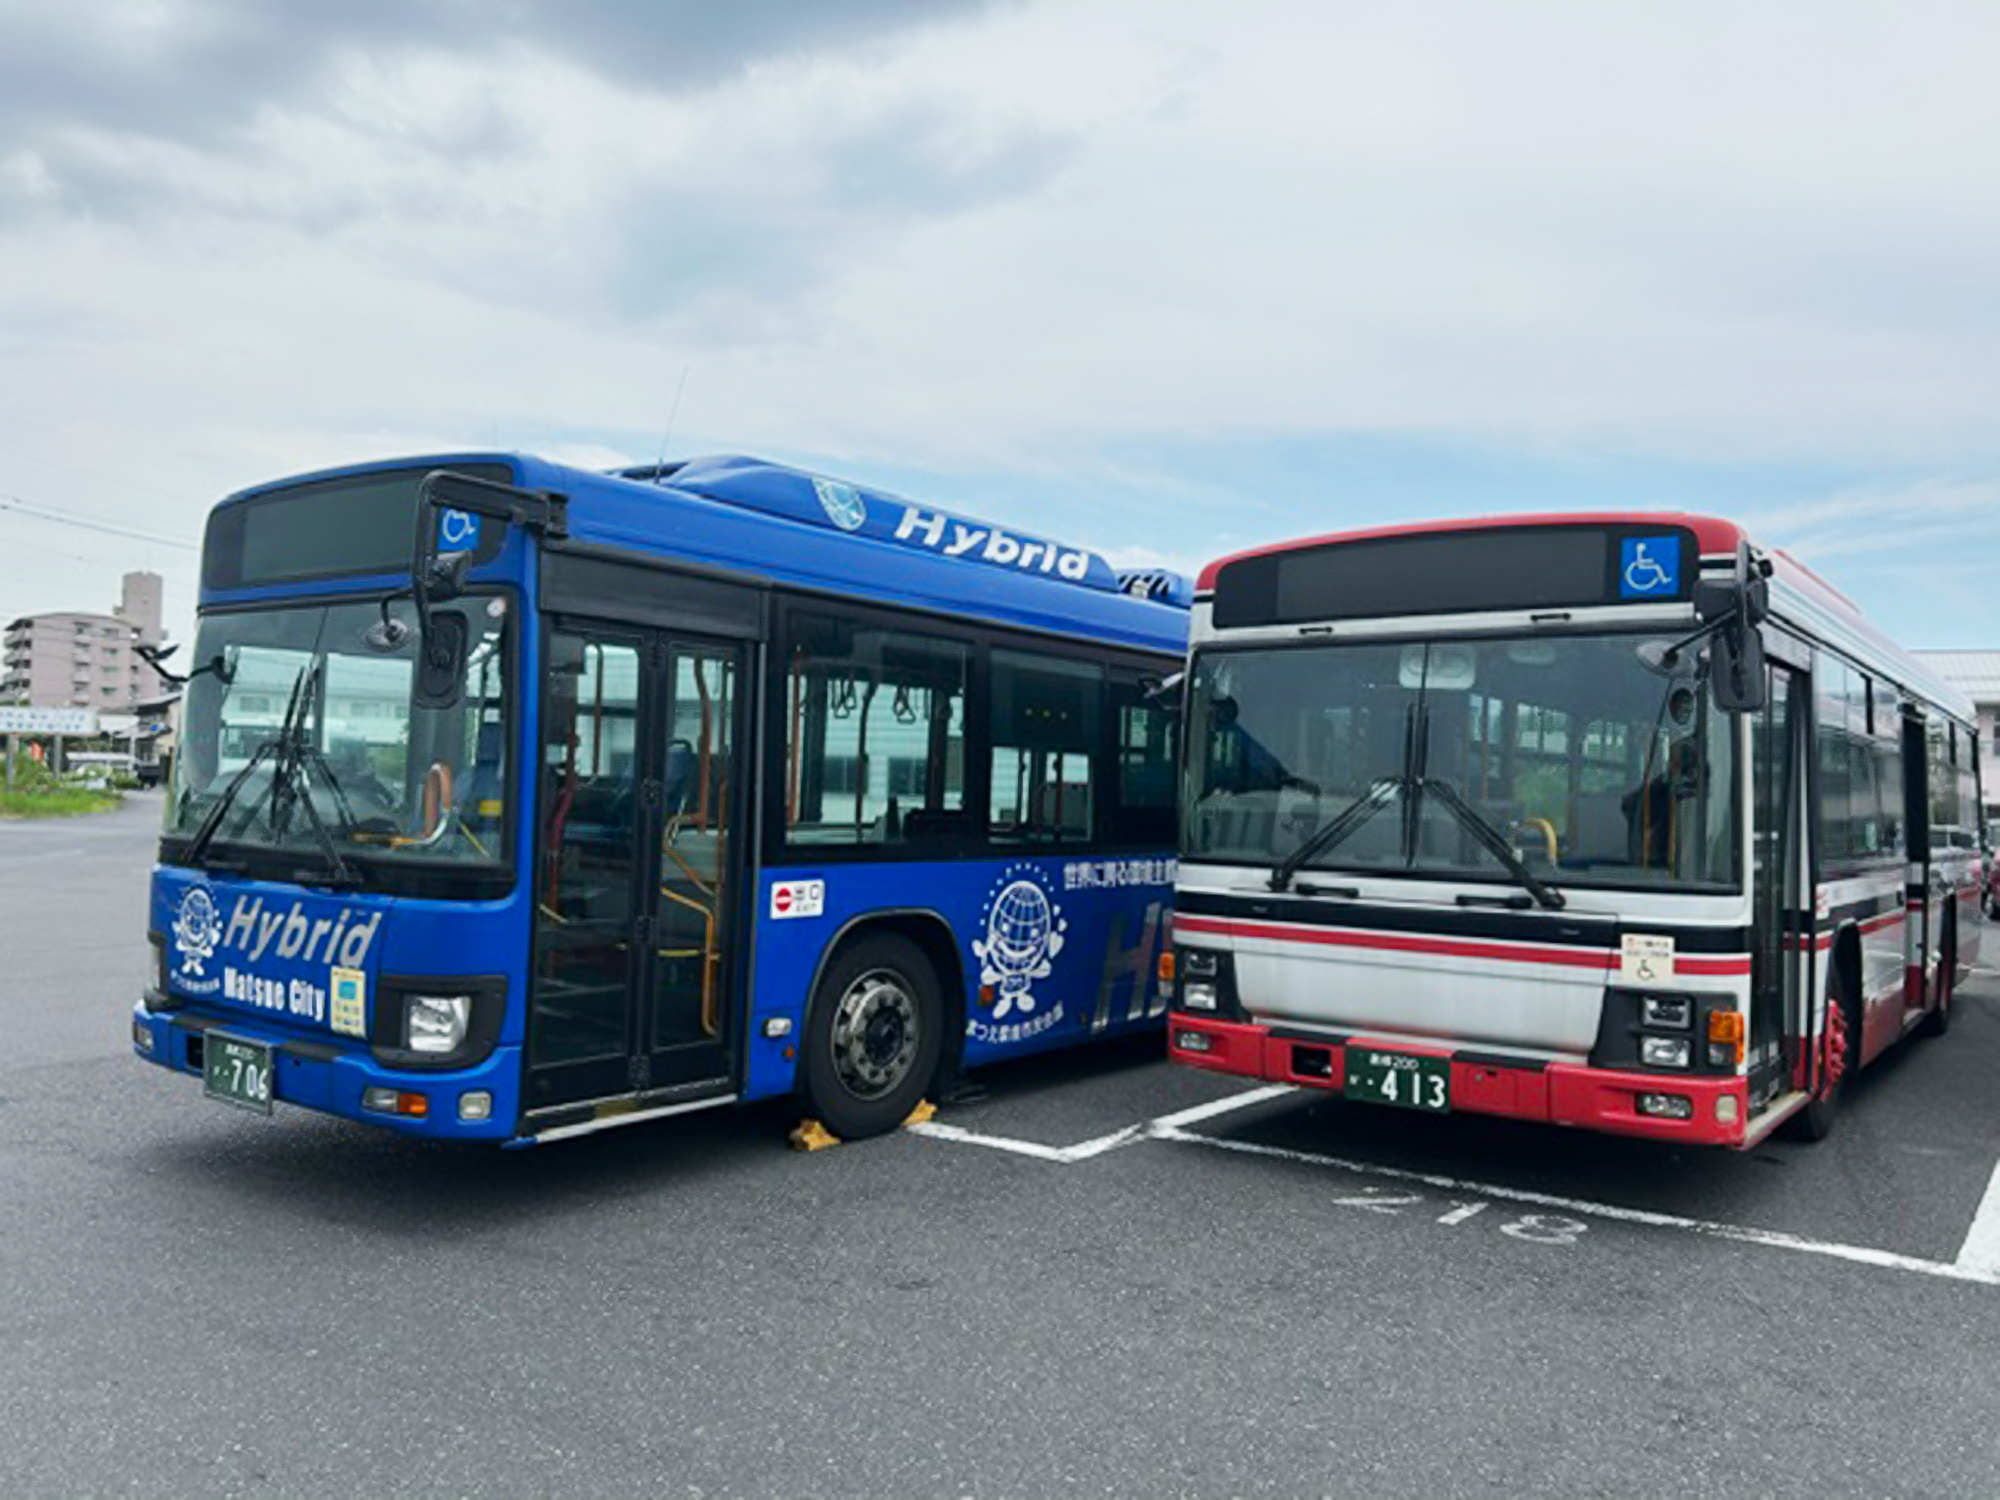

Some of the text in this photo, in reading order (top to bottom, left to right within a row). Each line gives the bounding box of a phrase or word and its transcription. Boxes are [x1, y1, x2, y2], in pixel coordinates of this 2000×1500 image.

[893, 506, 1090, 580] Hybrid
[222, 895, 382, 968] Hybrid
[1091, 901, 1174, 1035] H
[289, 978, 326, 1022] City
[231, 1058, 269, 1100] 706
[1381, 1069, 1446, 1109] 413
